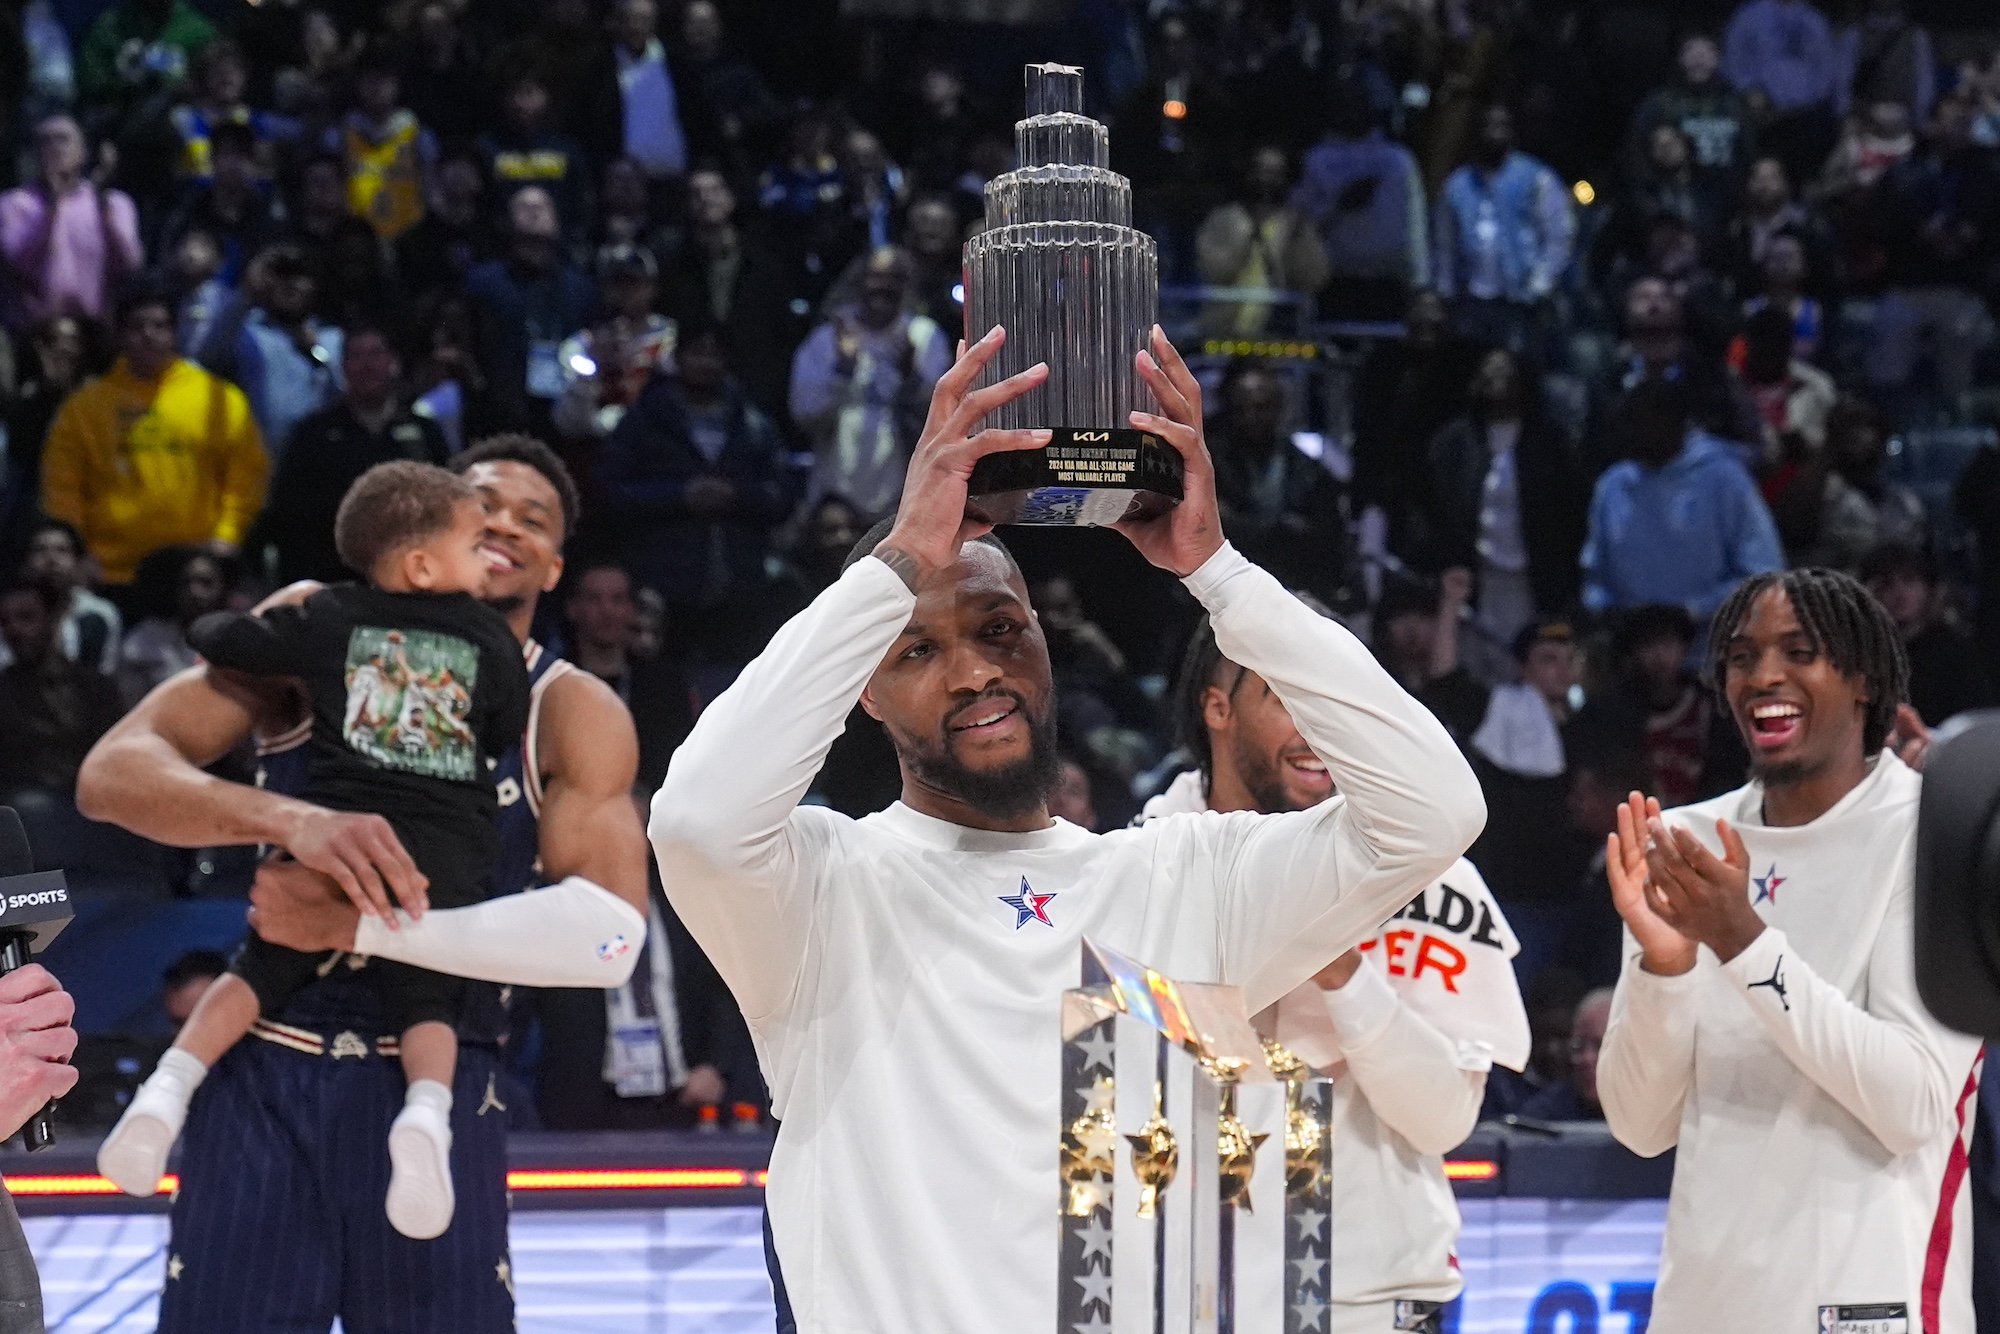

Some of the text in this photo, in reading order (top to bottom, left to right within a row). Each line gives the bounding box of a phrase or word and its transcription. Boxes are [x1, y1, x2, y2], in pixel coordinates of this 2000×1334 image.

[1073, 432, 1109, 441] KIA
[1047, 448, 1060, 458] THE
[1110, 448, 1137, 459] TROPHY
[1049, 460, 1135, 471] 2024 KIA NBA ALL-STAR GAME
[1058, 471, 1126, 482] MOST VALUABLE PLAYER
[8, 889, 67, 908] SPORTS
